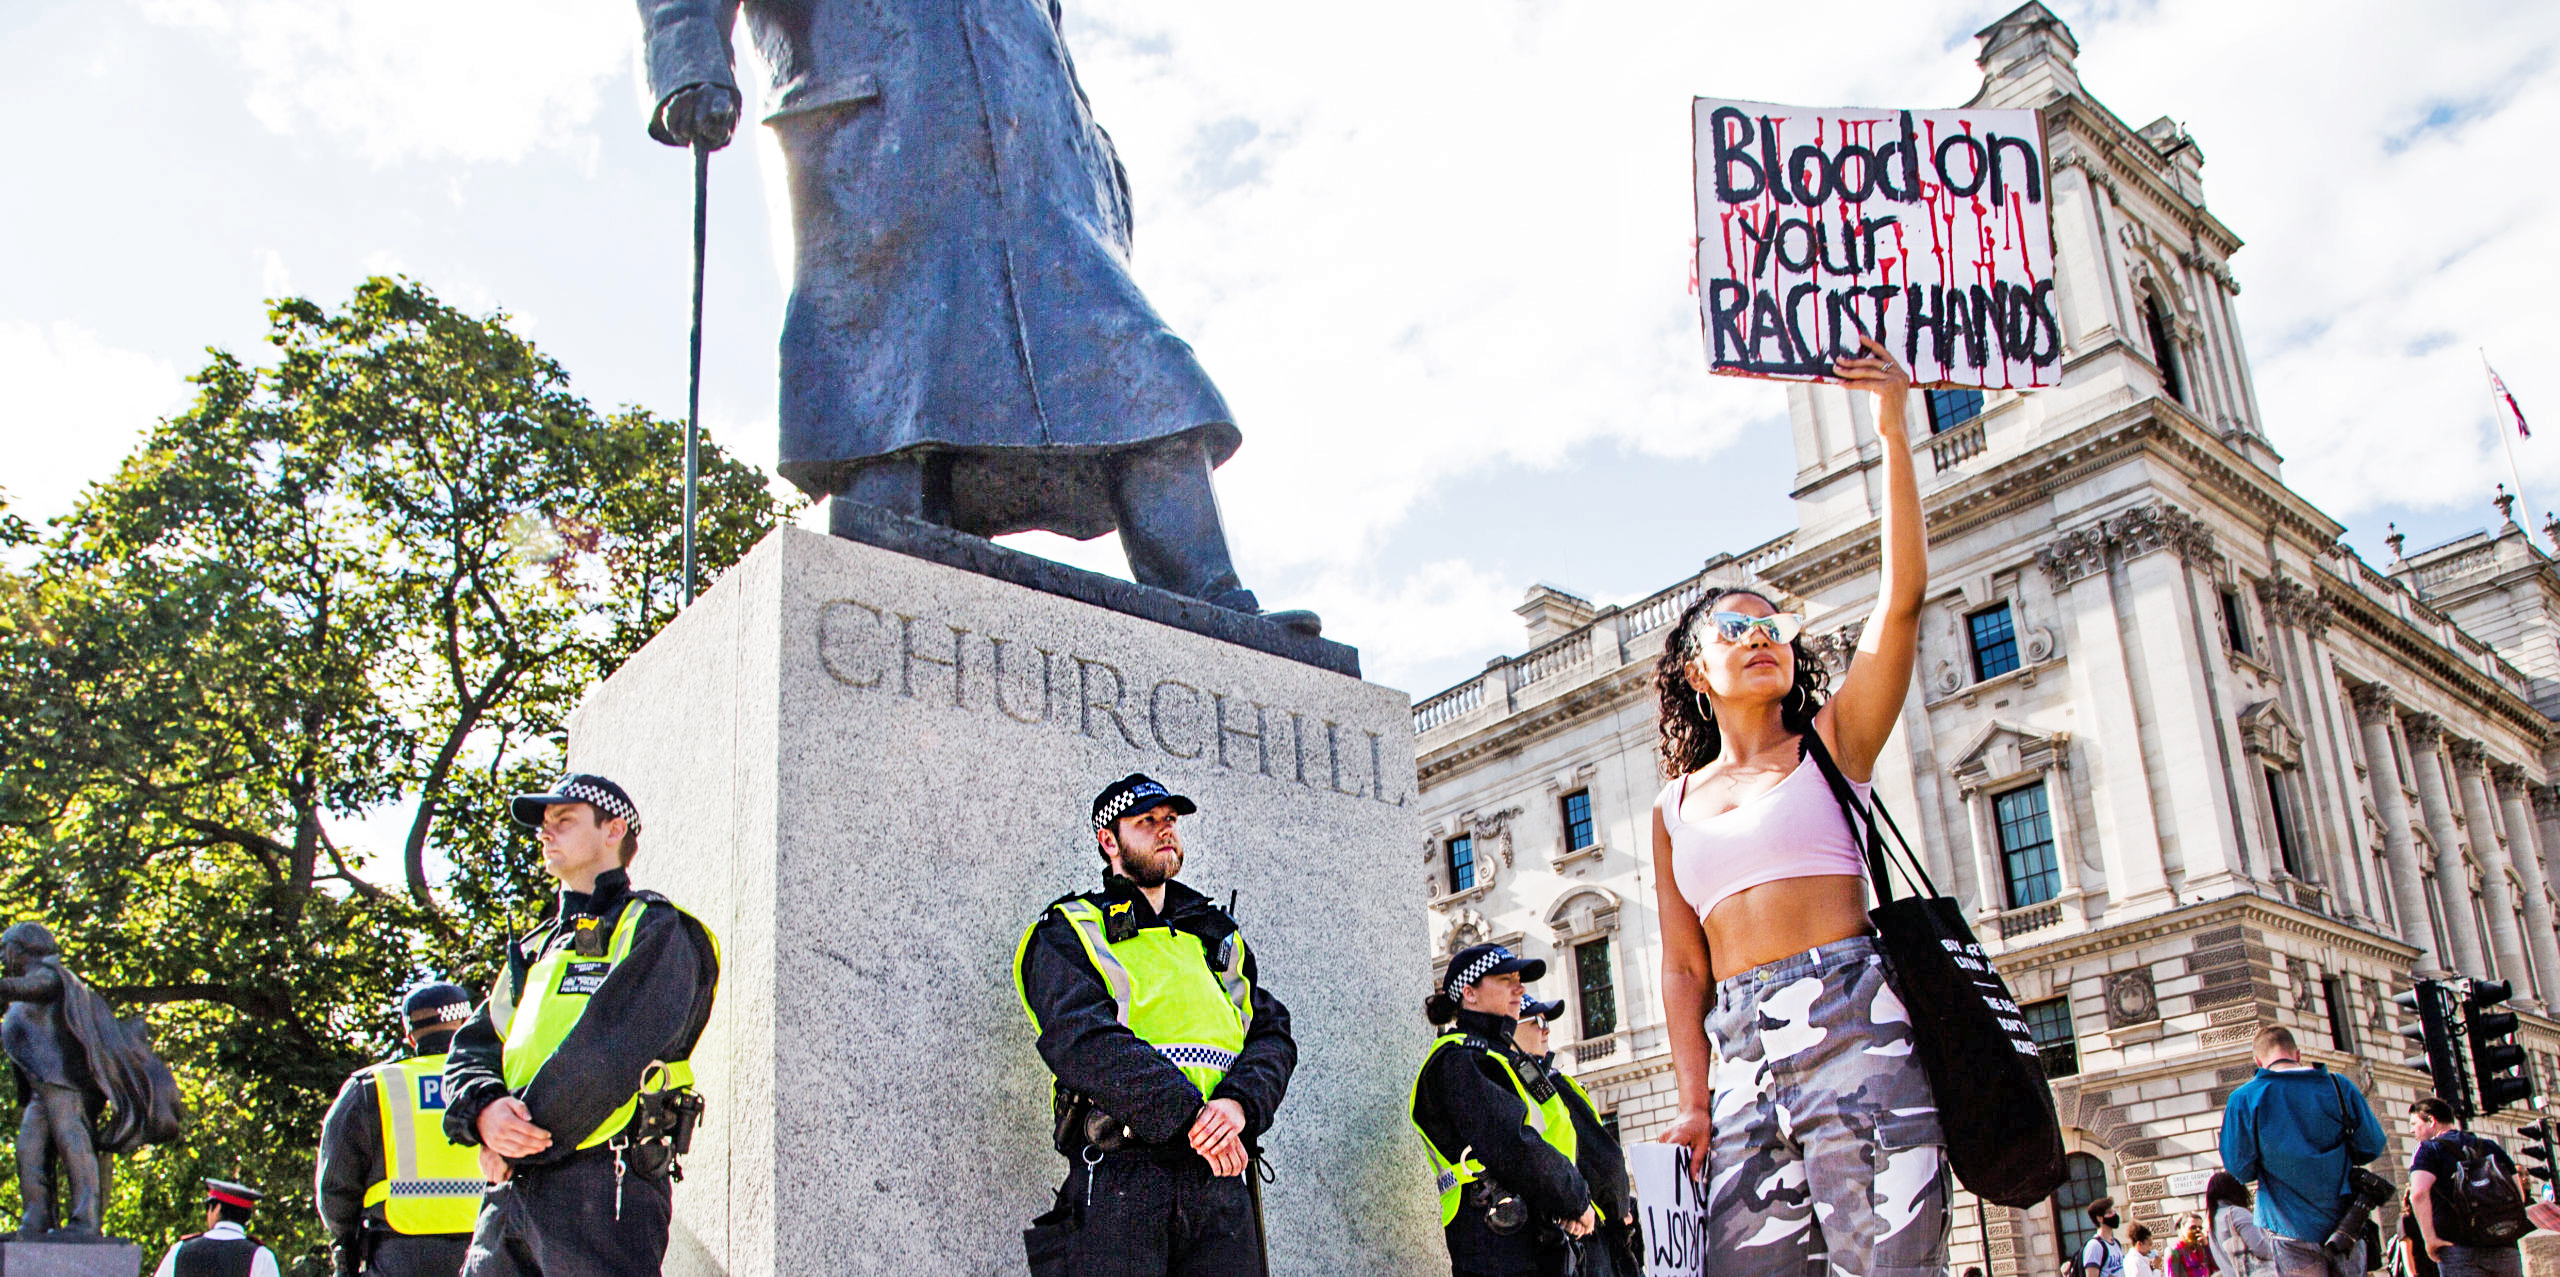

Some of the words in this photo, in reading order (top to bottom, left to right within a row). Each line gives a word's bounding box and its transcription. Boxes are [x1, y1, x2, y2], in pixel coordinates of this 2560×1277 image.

[1711, 106, 1921, 207] Blood
[1936, 132, 2042, 206] on
[1738, 210, 1899, 279] your
[1710, 278, 1901, 367] RACIST
[1907, 278, 2060, 373] HANDS
[816, 598, 1405, 807] CHURCHILL
